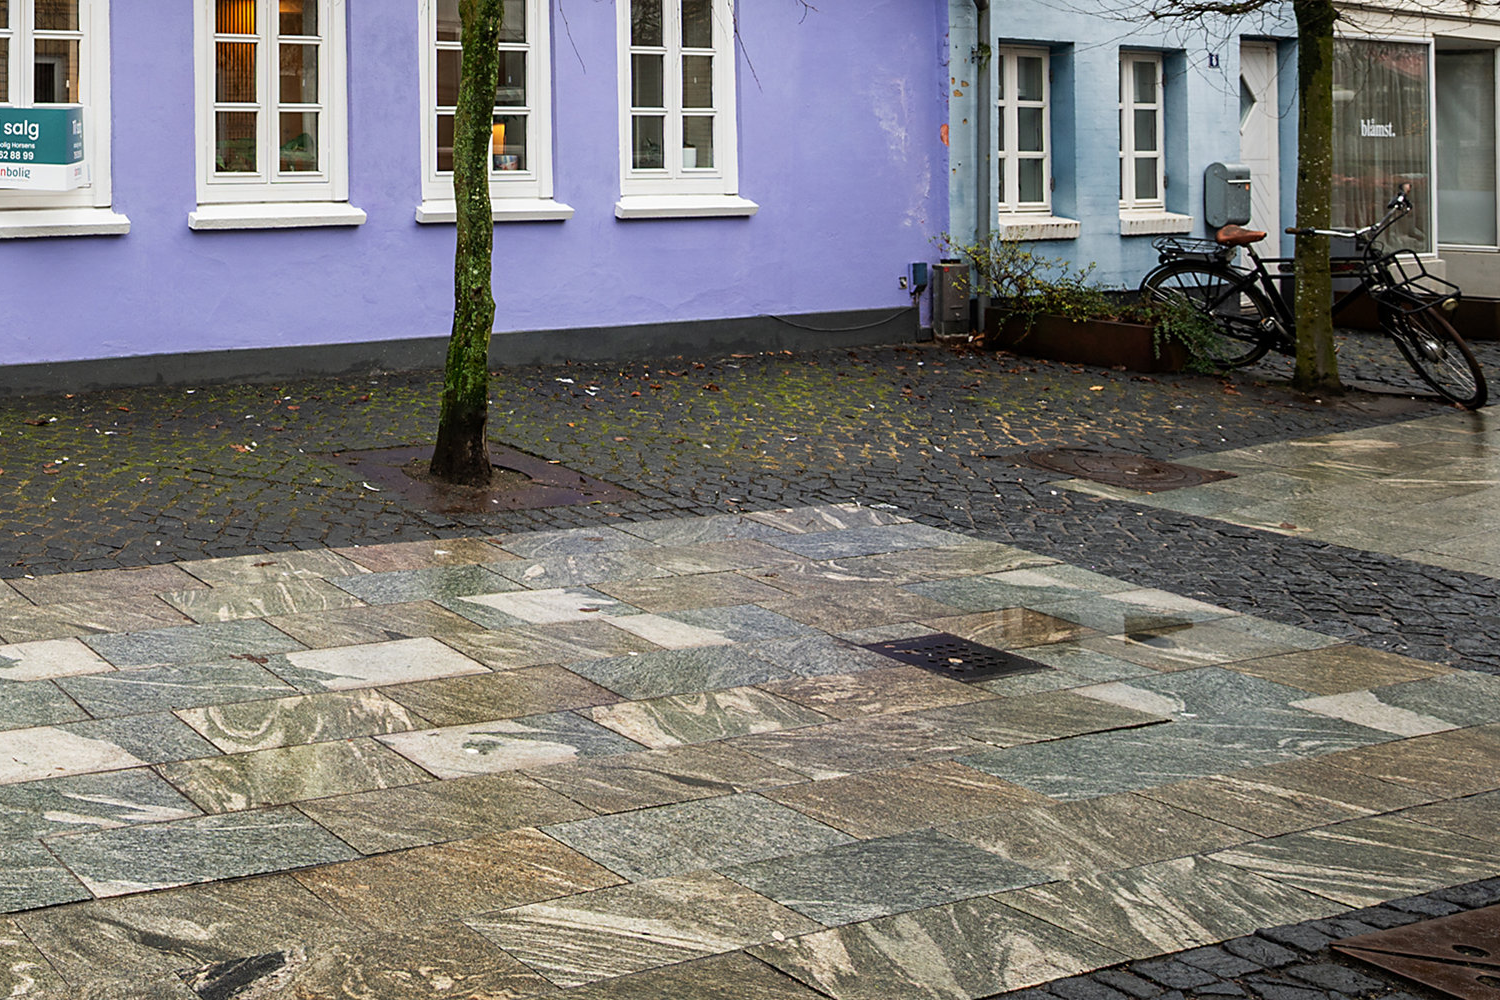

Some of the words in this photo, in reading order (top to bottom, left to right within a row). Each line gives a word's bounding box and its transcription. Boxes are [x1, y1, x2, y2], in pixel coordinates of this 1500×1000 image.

[3, 119, 40, 141] salg
[1360, 118, 1396, 137] blåmst.
[10, 151, 21, 160] 88
[22, 151, 34, 161] 99
